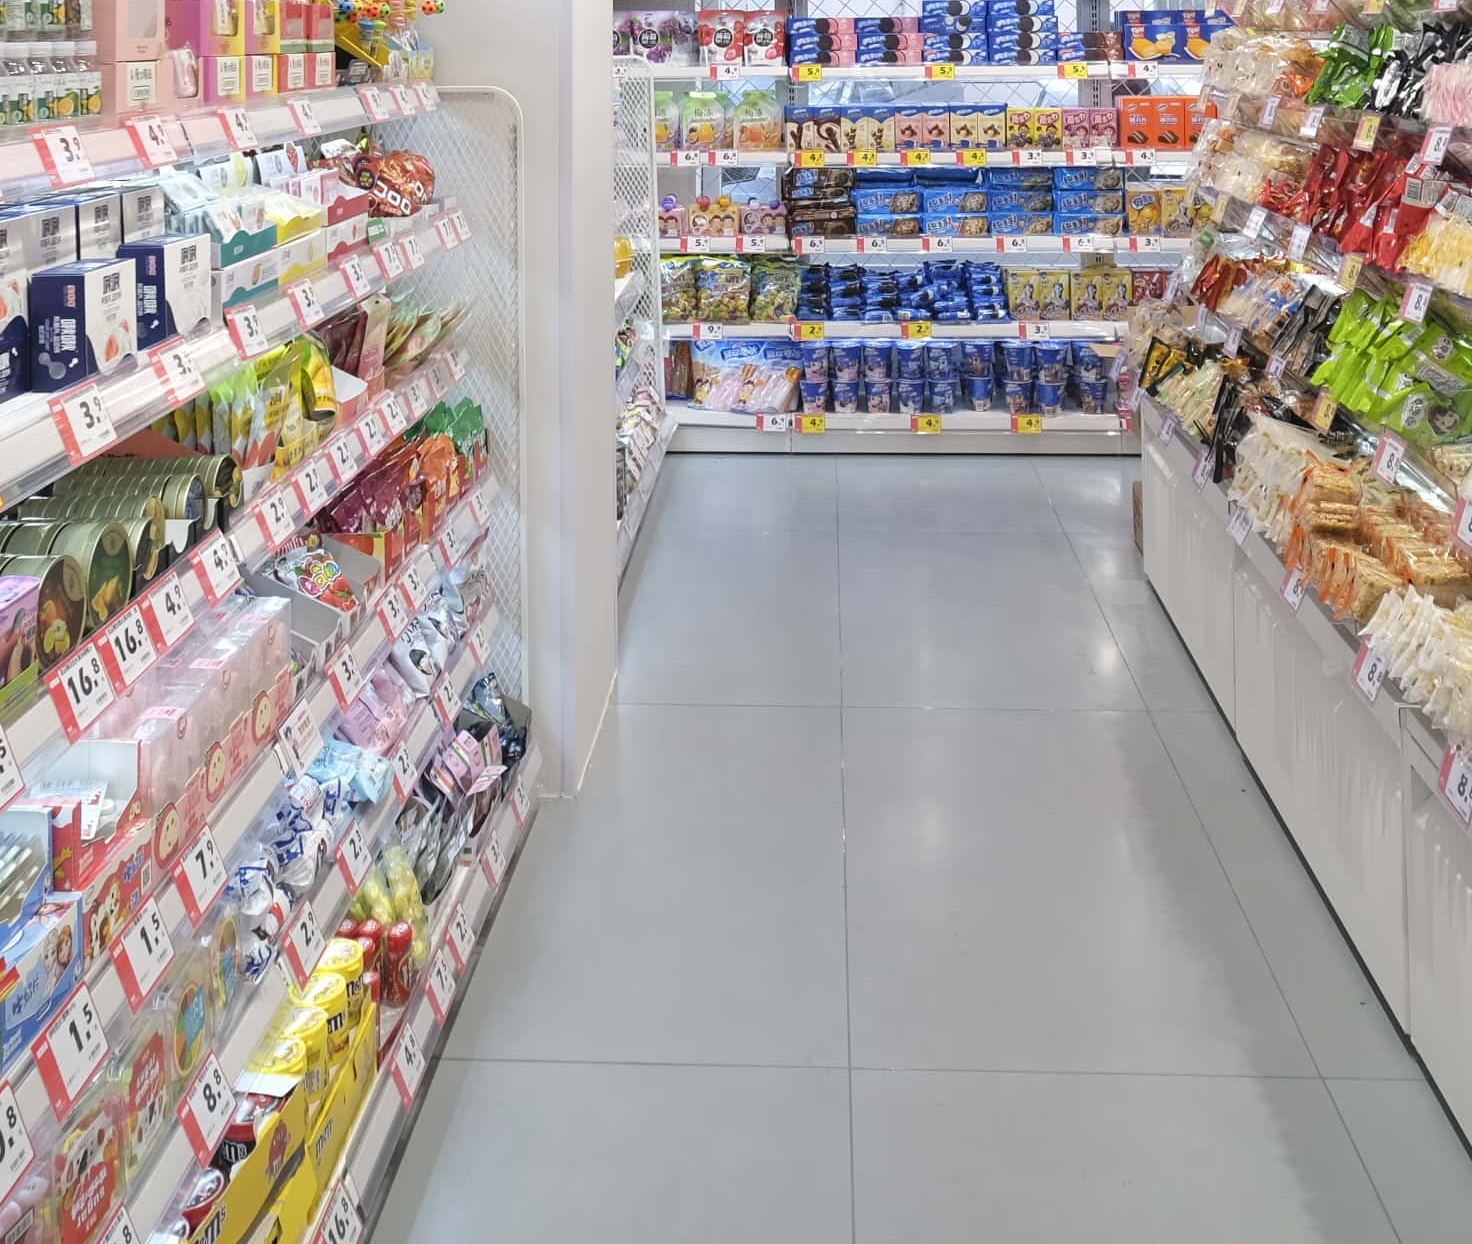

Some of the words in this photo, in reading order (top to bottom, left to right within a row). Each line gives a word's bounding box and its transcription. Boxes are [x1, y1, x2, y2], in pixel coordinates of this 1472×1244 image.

[59, 133, 82, 164] 3.9
[80, 394, 102, 431] 3.9
[271, 498, 284, 522] 2.9
[164, 583, 183, 617] 4.9
[114, 618, 146, 664] 16.8
[67, 657, 102, 706] 16.8
[341, 654, 355, 681] 3.9
[193, 841, 216, 882] 7.9
[139, 915, 161, 956] 1.5
[300, 912, 315, 947] 2.9
[68, 1003, 94, 1054] 1.5
[202, 1067, 223, 1113] 8.8
